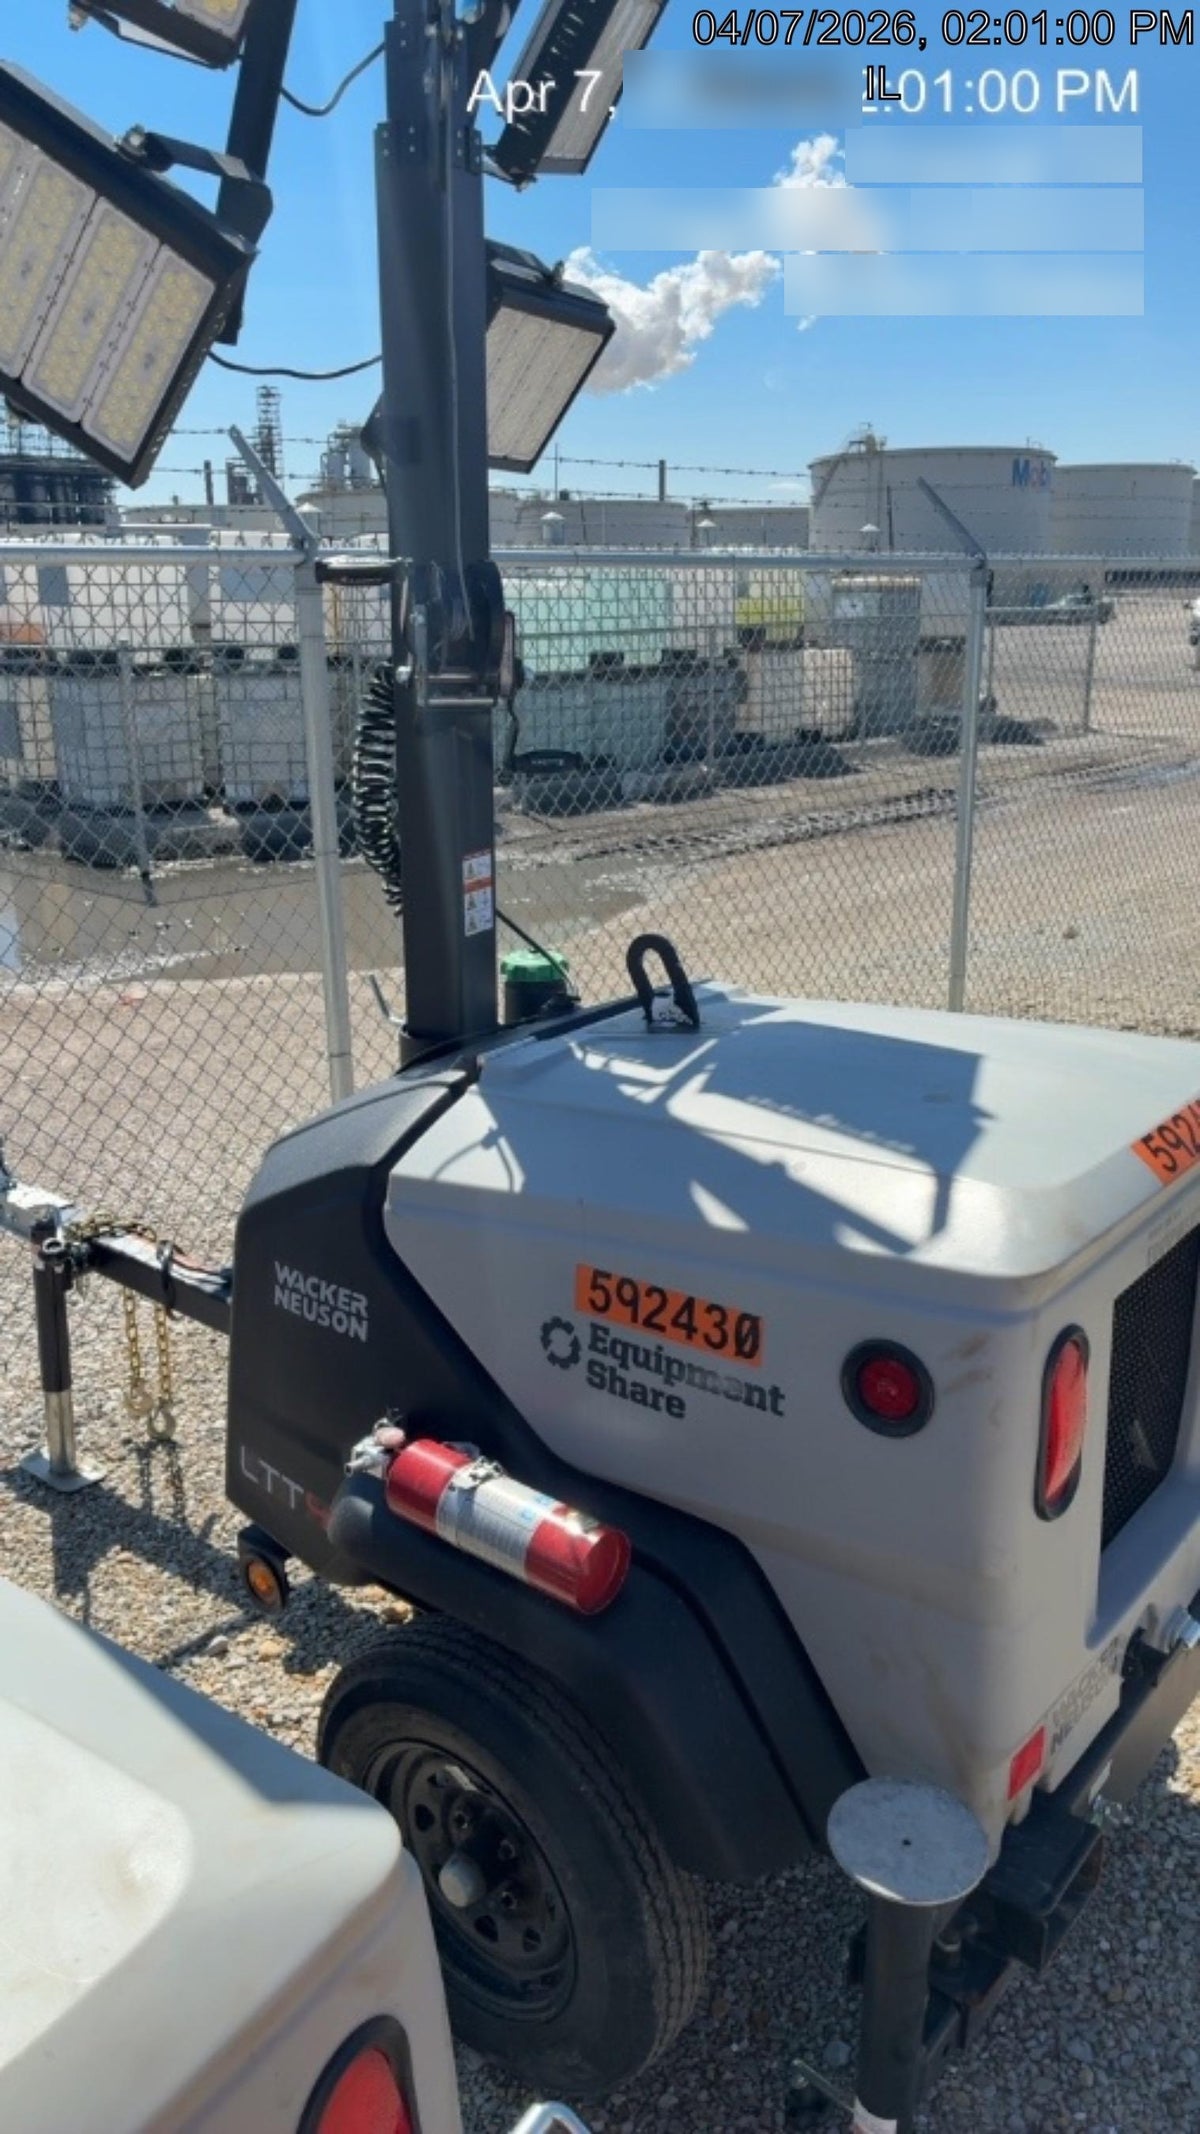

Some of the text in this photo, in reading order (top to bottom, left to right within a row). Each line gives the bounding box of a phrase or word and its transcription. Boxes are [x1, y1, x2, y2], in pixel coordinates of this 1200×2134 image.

[274, 1260, 369, 1319] WACKER
[274, 1284, 369, 1342] NEUSON
[588, 1267, 762, 1360] 592430
[586, 1358, 687, 1419] Share
[588, 1321, 786, 1417] Equipment
